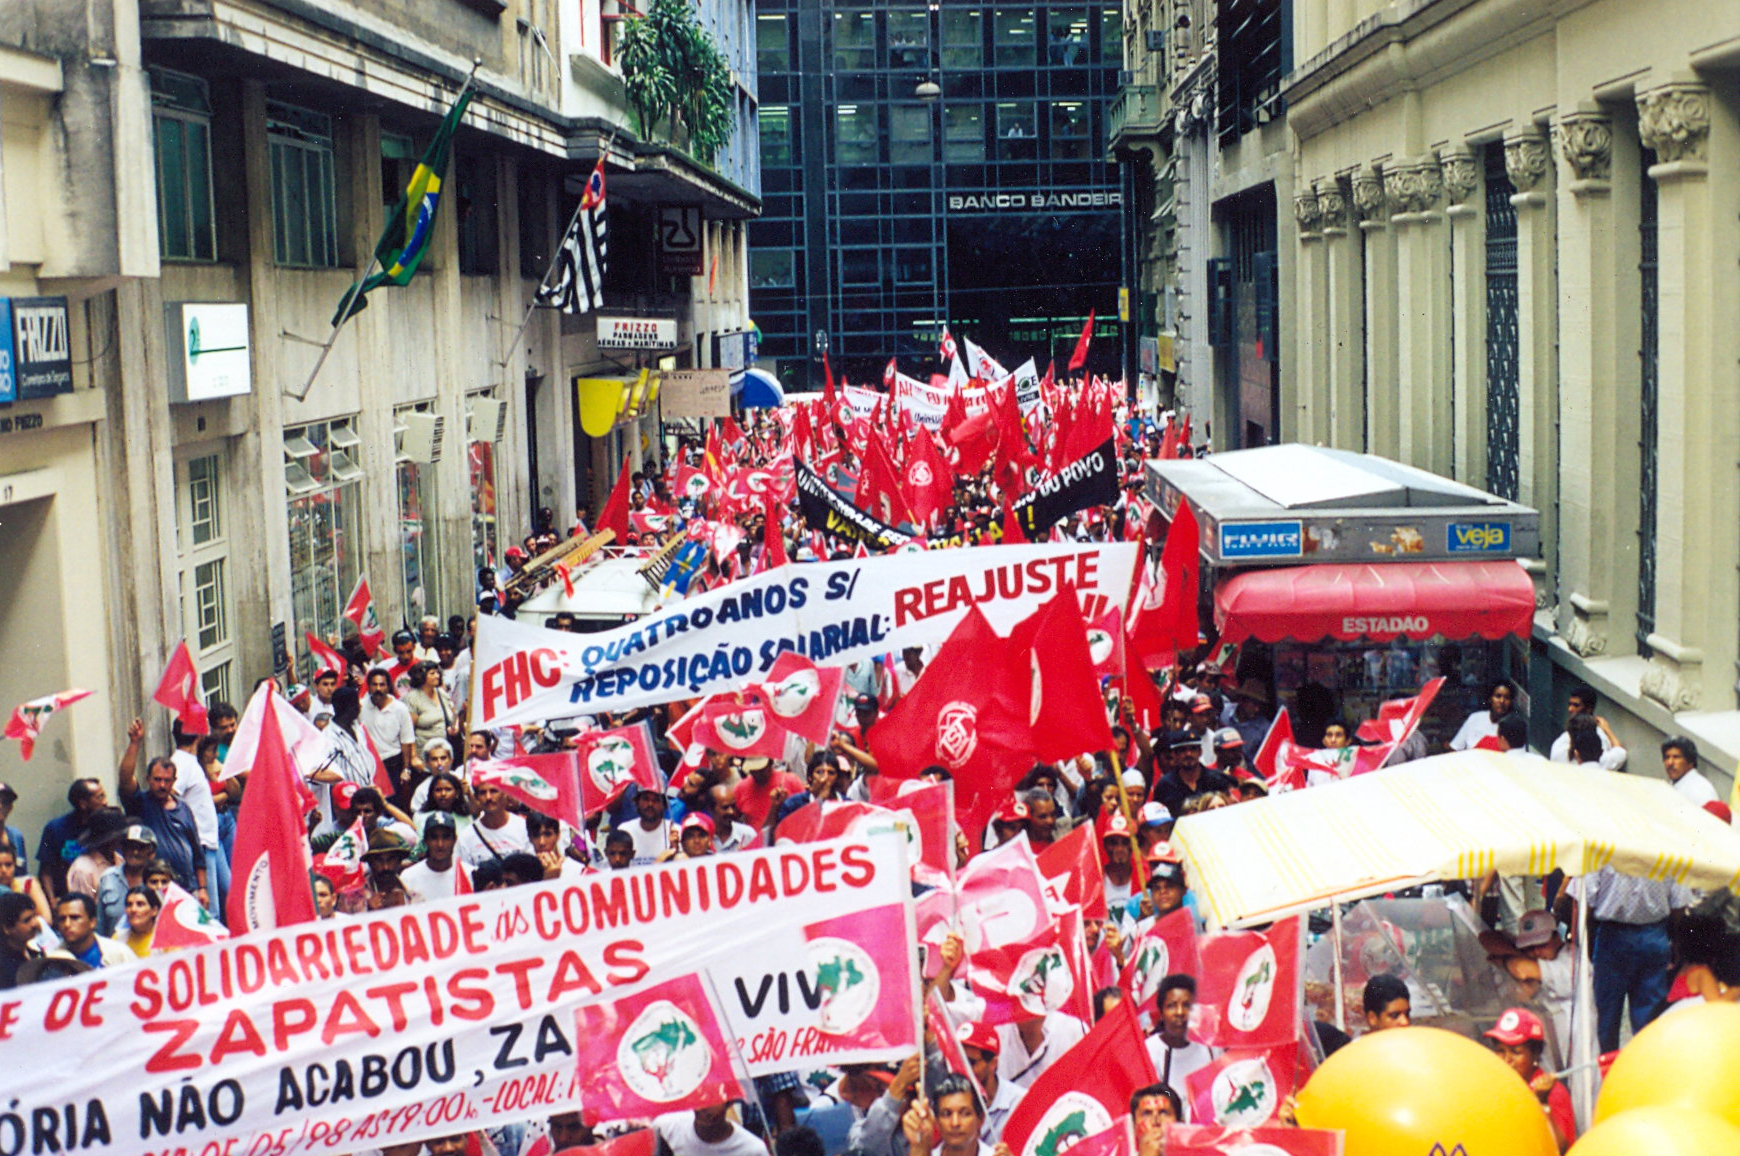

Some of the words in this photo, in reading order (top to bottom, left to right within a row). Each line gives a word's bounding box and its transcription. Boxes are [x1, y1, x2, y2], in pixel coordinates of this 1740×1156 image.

[949, 195, 1026, 209] BANCO
[16, 307, 69, 363] FRIZZO
[612, 331, 659, 340] PASSAGENS
[613, 321, 658, 333] FRIZZO
[1060, 451, 1105, 488] POVO
[1456, 523, 1504, 549] veja
[894, 550, 1100, 628] REAJUSTE
[581, 606, 713, 674] QUATRO
[716, 577, 809, 626] ANOS
[824, 567, 861, 601] S/
[481, 648, 570, 723] FHC:
[569, 642, 751, 704] REPOSIÇÃO
[130, 903, 489, 1020] SOLIDARIEDADE
[533, 844, 876, 941] COMUNIDADES
[142, 940, 650, 1073] ZAPATISTAS
[139, 1076, 245, 1140] NÃO
[734, 969, 823, 1019] VIV
[747, 1026, 788, 1064] SÃO
